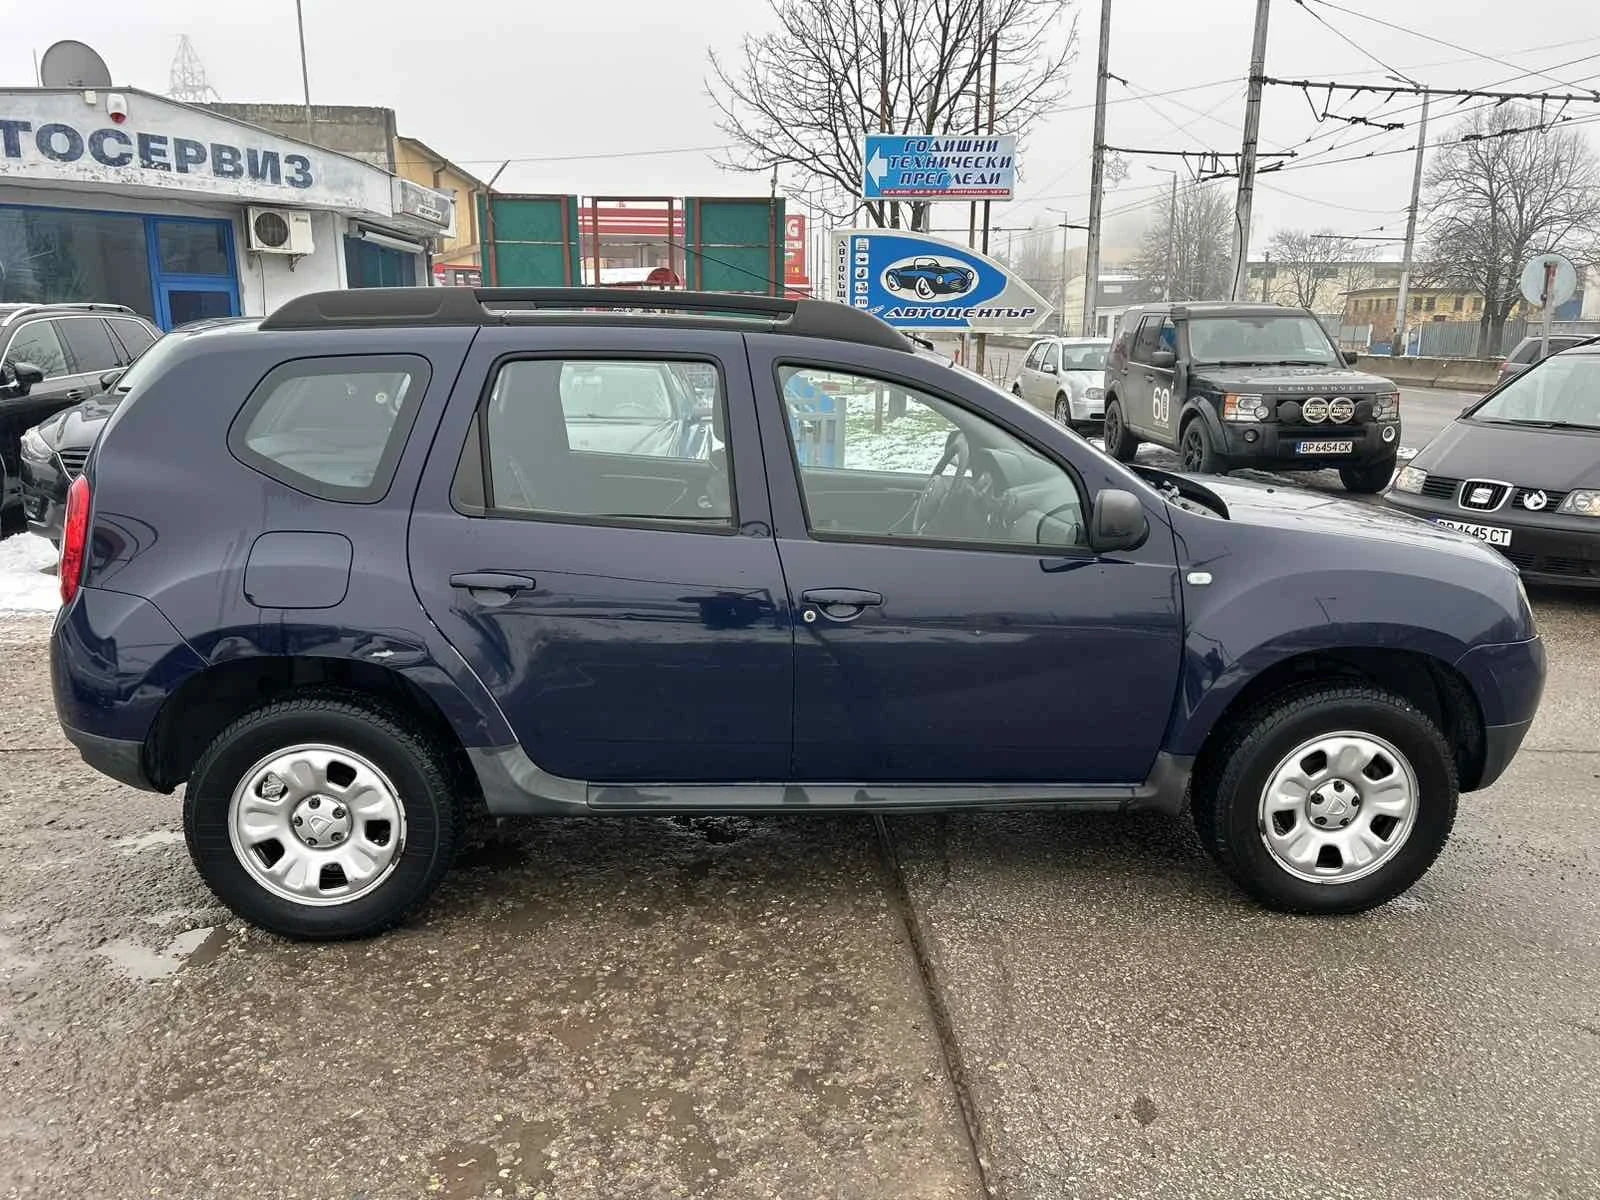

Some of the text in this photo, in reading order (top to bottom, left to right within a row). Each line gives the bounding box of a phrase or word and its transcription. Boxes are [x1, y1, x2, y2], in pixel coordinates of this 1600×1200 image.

[904, 139, 999, 153] ГОДИШНИ
[890, 156, 1012, 169] ТЕХНИЧЕСКИ
[900, 172, 1001, 185] ПРЕГЛЕДИ
[884, 307, 1036, 320] АВТОЦЕНТЪР
[1153, 387, 1170, 422] 60
[1490, 529, 1509, 543] CT
